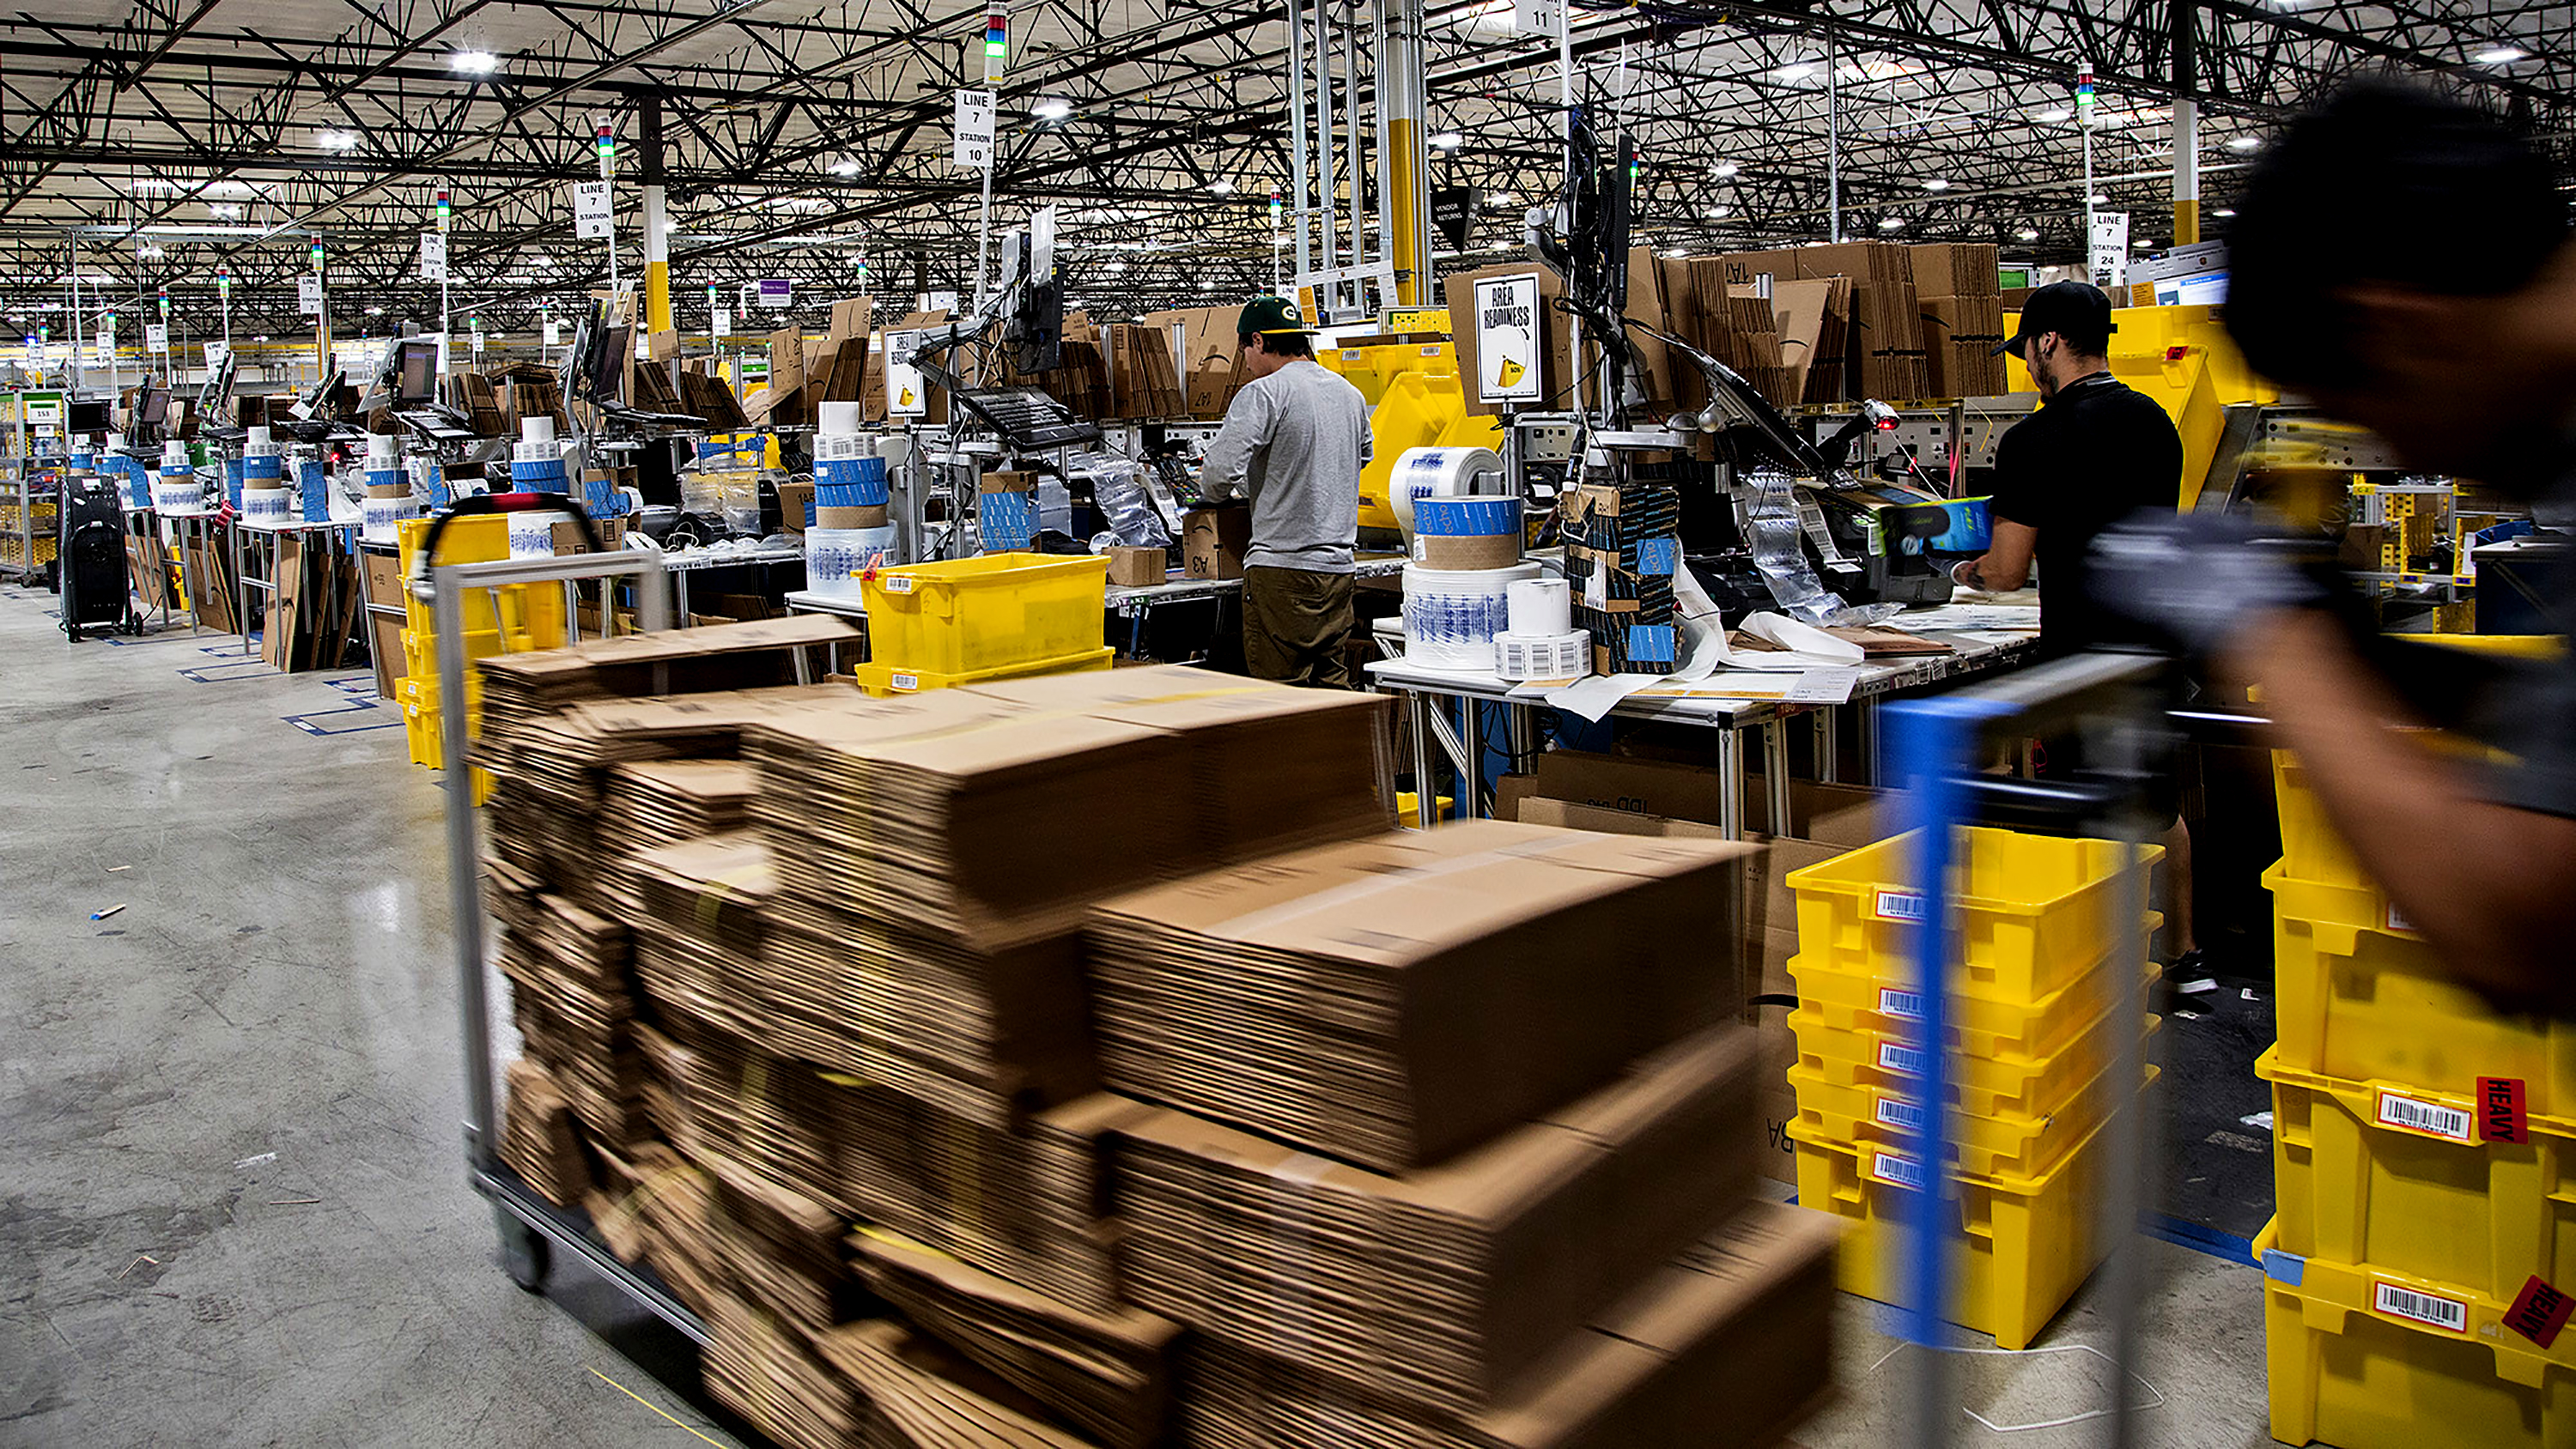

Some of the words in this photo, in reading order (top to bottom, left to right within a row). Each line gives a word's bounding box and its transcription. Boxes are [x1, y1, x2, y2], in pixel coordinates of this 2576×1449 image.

[1533, 10, 1547, 27] 11
[963, 94, 988, 107] LINE
[972, 112, 981, 123] 7
[959, 133, 990, 143] STATION
[969, 149, 982, 161] 10
[580, 184, 605, 194] LINE
[590, 197, 598, 206] 7
[2097, 215, 2122, 225] LINE
[592, 224, 600, 233] 9
[2105, 228, 2113, 237] 7
[424, 236, 439, 245] LINE
[2101, 256, 2114, 264] 24
[1492, 286, 1515, 307] AREA
[1484, 306, 1530, 330] READINESS
[1421, 504, 1434, 533] echo
[1438, 504, 1454, 534] echo
[1645, 541, 1662, 572] echo
[1192, 555, 1209, 573] A3
[2488, 1079, 2515, 1143] HEAVY
[2515, 1282, 2565, 1341] HEAVY
